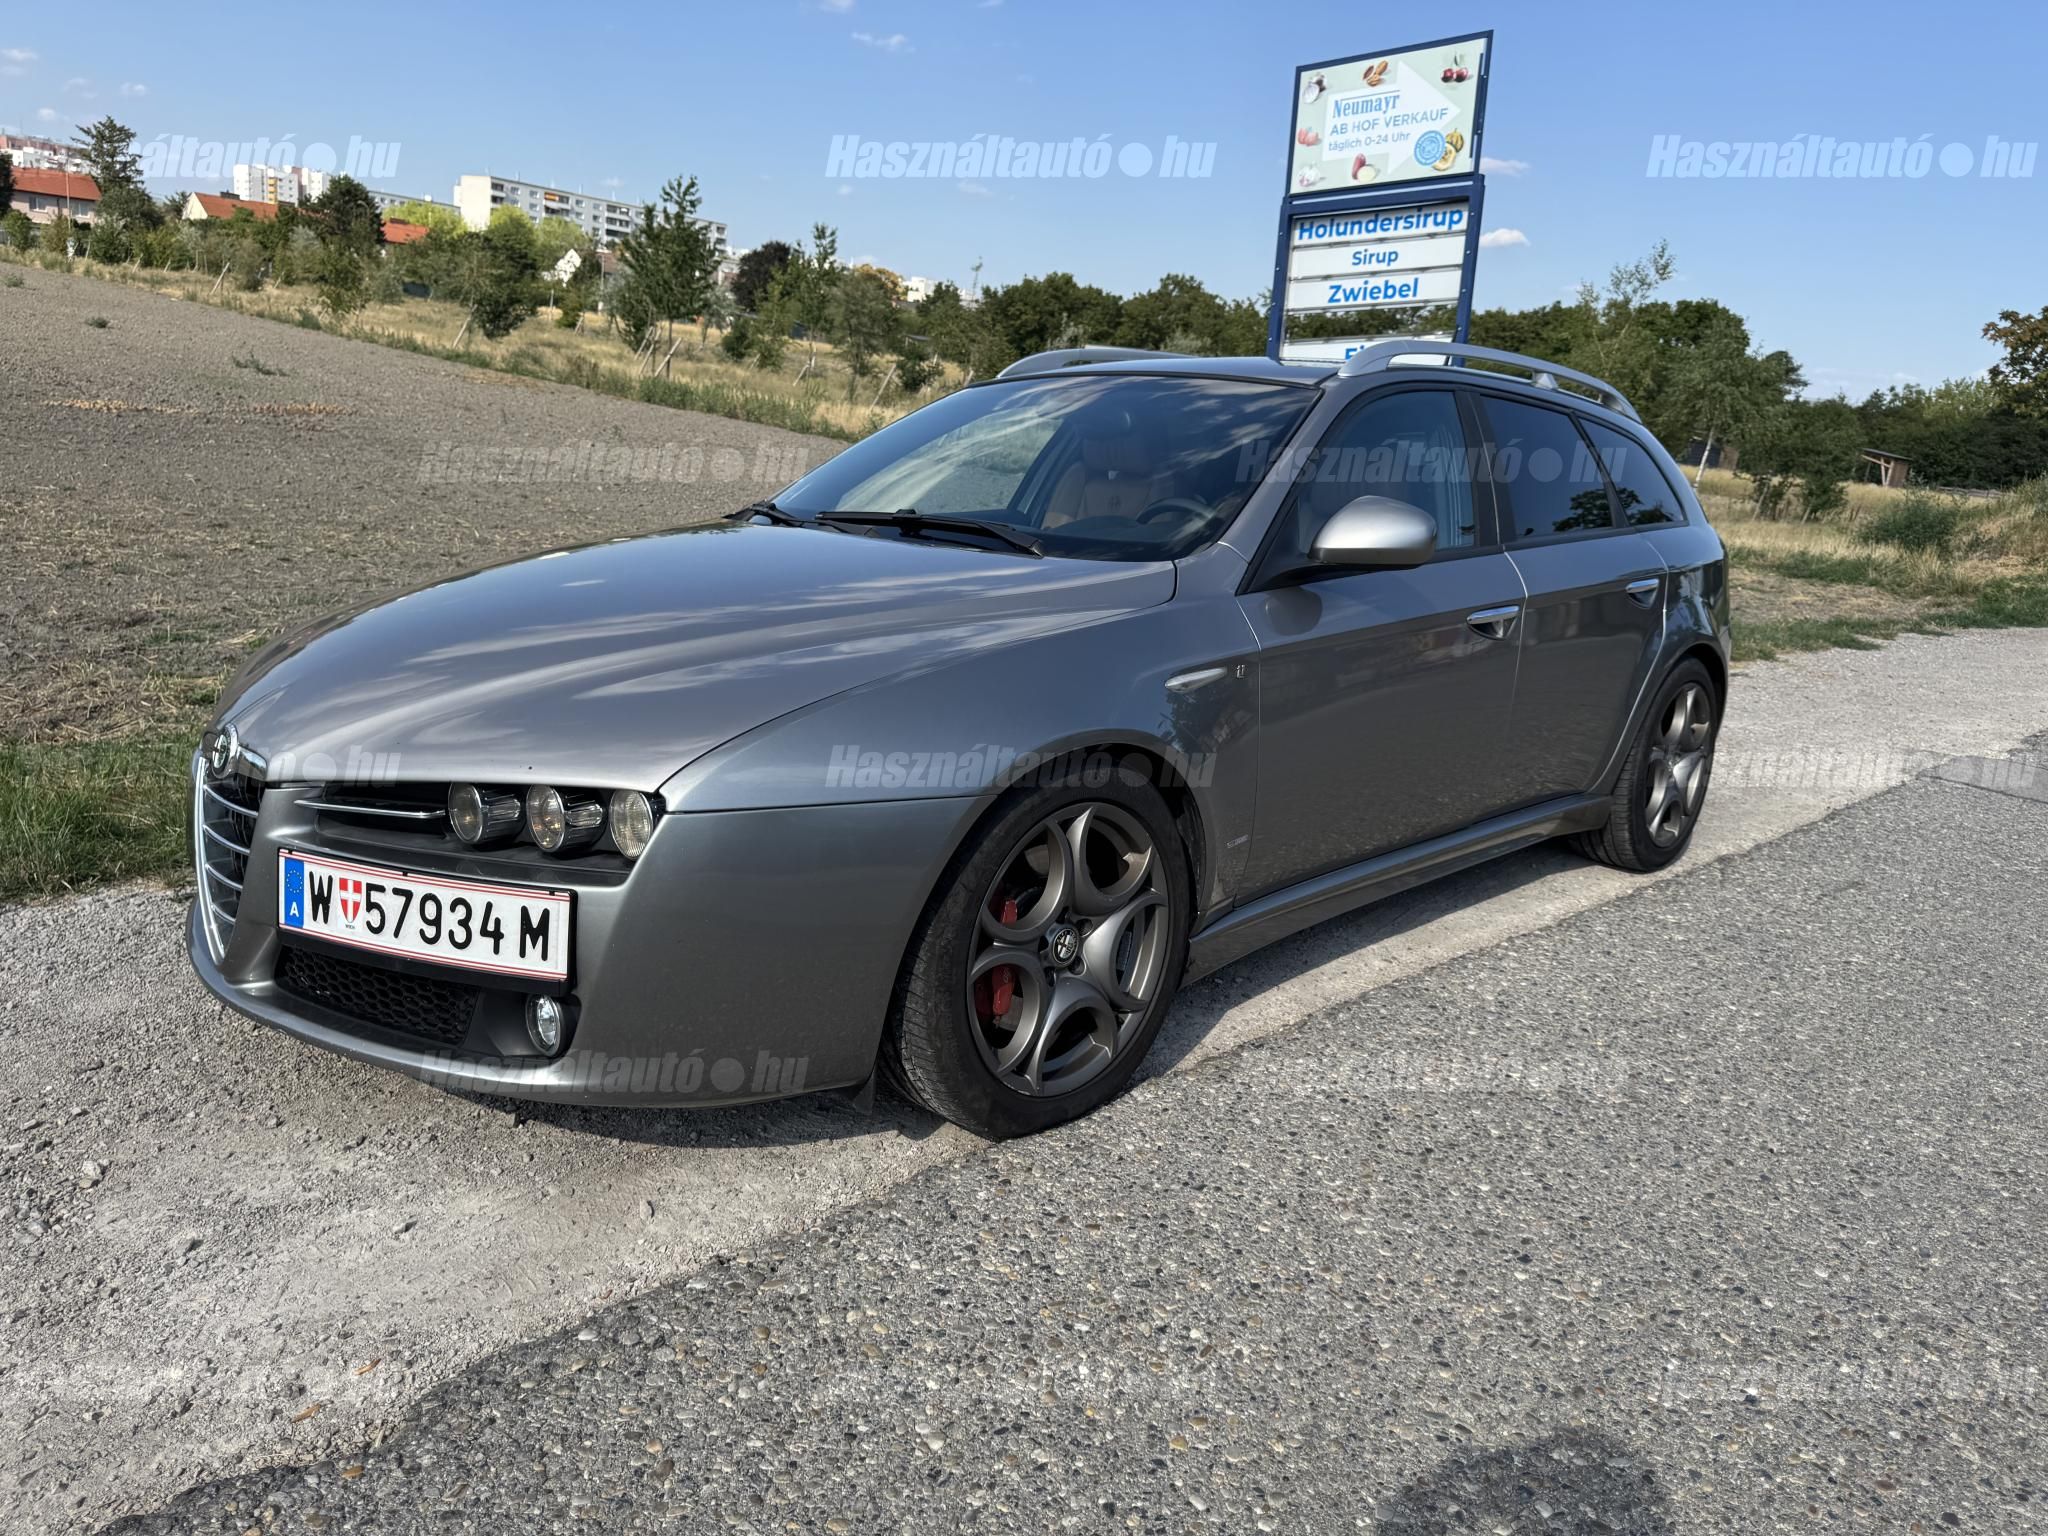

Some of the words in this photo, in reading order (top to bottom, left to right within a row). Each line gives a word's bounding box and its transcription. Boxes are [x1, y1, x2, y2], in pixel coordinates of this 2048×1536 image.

[1332, 95, 1400, 118] Neumayr
[1330, 123, 1348, 136] AB
[1352, 118, 1380, 132] HOF
[1384, 108, 1448, 128] VERKAUF
[1328, 138, 1362, 151] täglich
[1364, 136, 1389, 146] 0-24
[1391, 132, 1411, 143] Uhr
[1298, 208, 1463, 239] Holundersirup
[1351, 248, 1399, 266] Sirup
[1328, 277, 1419, 303] Zwiebel
[289, 901, 300, 918] A
[309, 871, 334, 924] W
[365, 882, 505, 955] 57934
[519, 905, 550, 962] M
